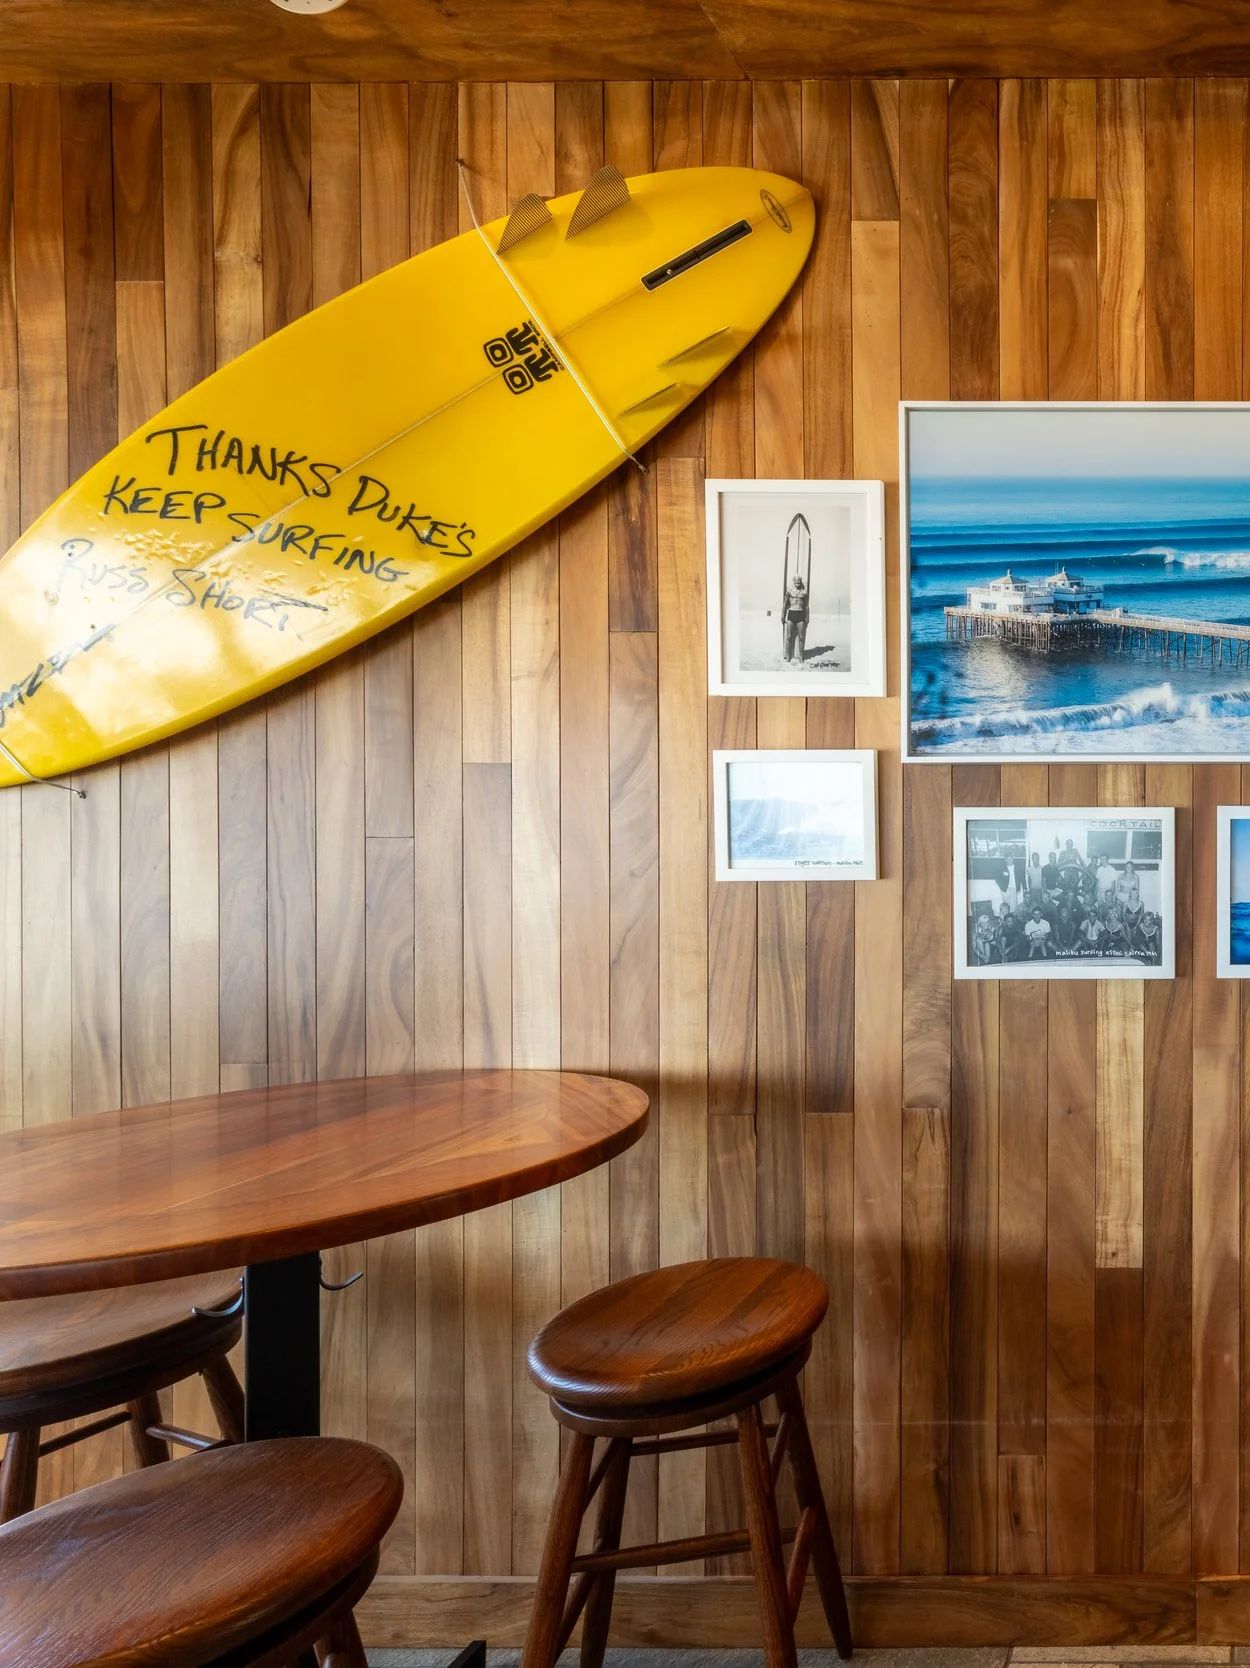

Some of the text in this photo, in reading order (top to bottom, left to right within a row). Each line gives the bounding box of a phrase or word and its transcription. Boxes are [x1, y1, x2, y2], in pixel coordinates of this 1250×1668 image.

[103, 475, 410, 583] KEEP SURFING
[145, 424, 479, 559] THANKS DUKE'S
[56, 538, 149, 593] RUSS
